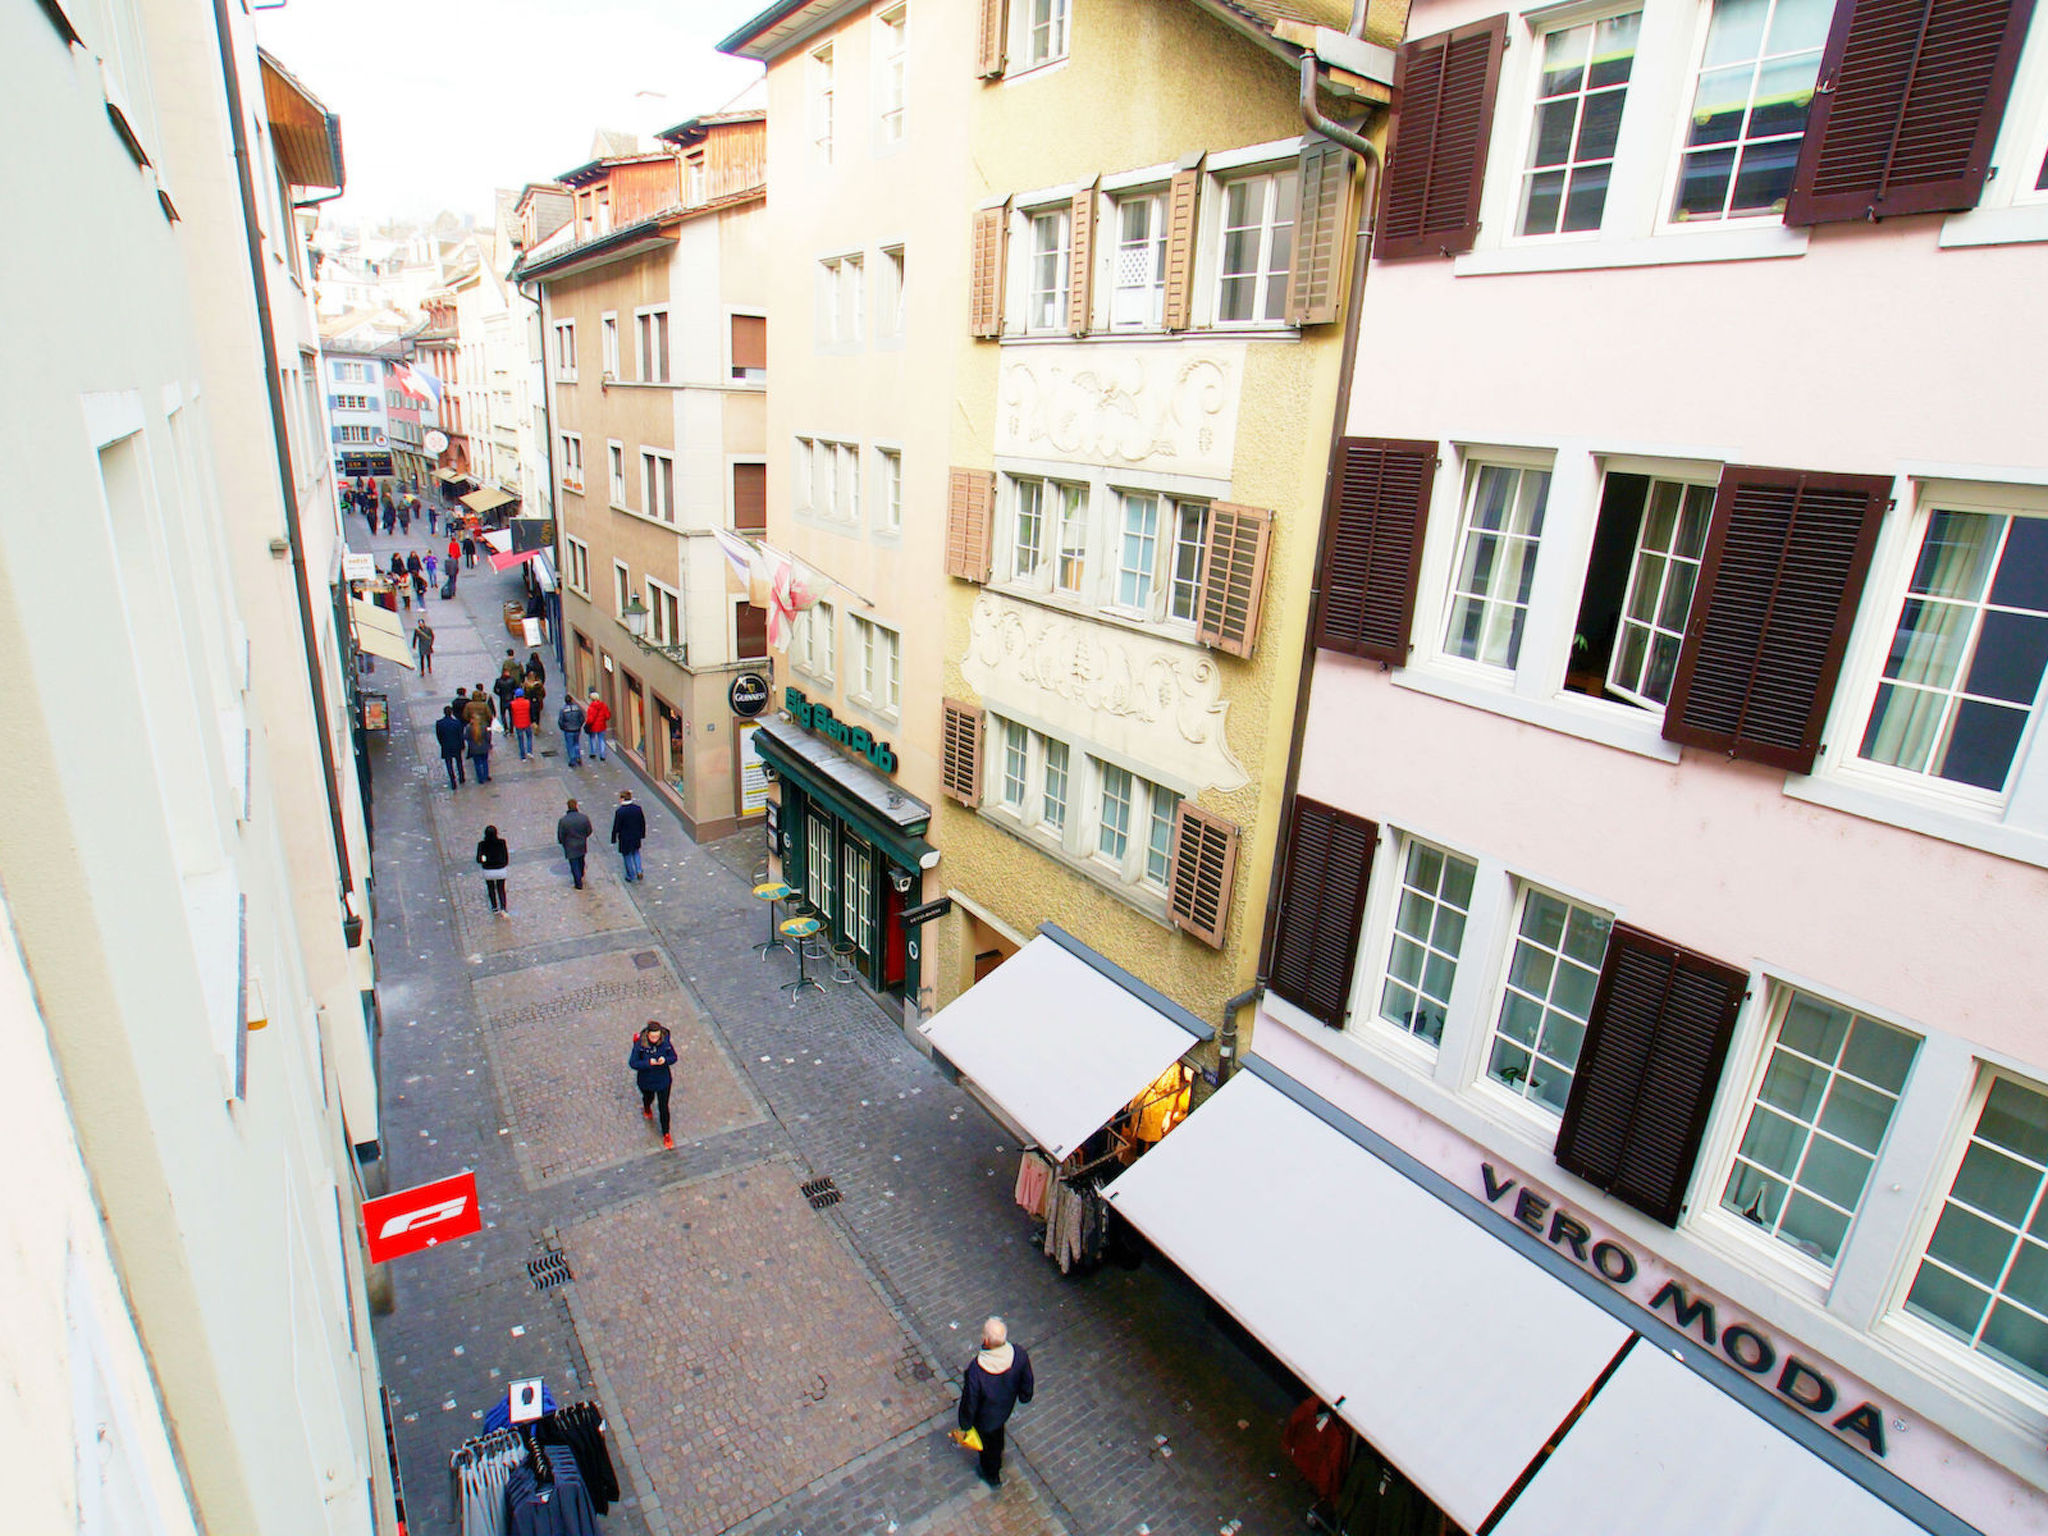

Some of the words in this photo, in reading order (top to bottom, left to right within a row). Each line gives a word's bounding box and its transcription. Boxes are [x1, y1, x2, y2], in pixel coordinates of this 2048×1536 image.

[735, 692, 766, 702] GUINNESS
[785, 686, 813, 729] Big
[813, 702, 852, 747] Ben
[851, 726, 898, 774] Pub
[1481, 1162, 1638, 1284] VERO
[1648, 1279, 1888, 1458] MODA
